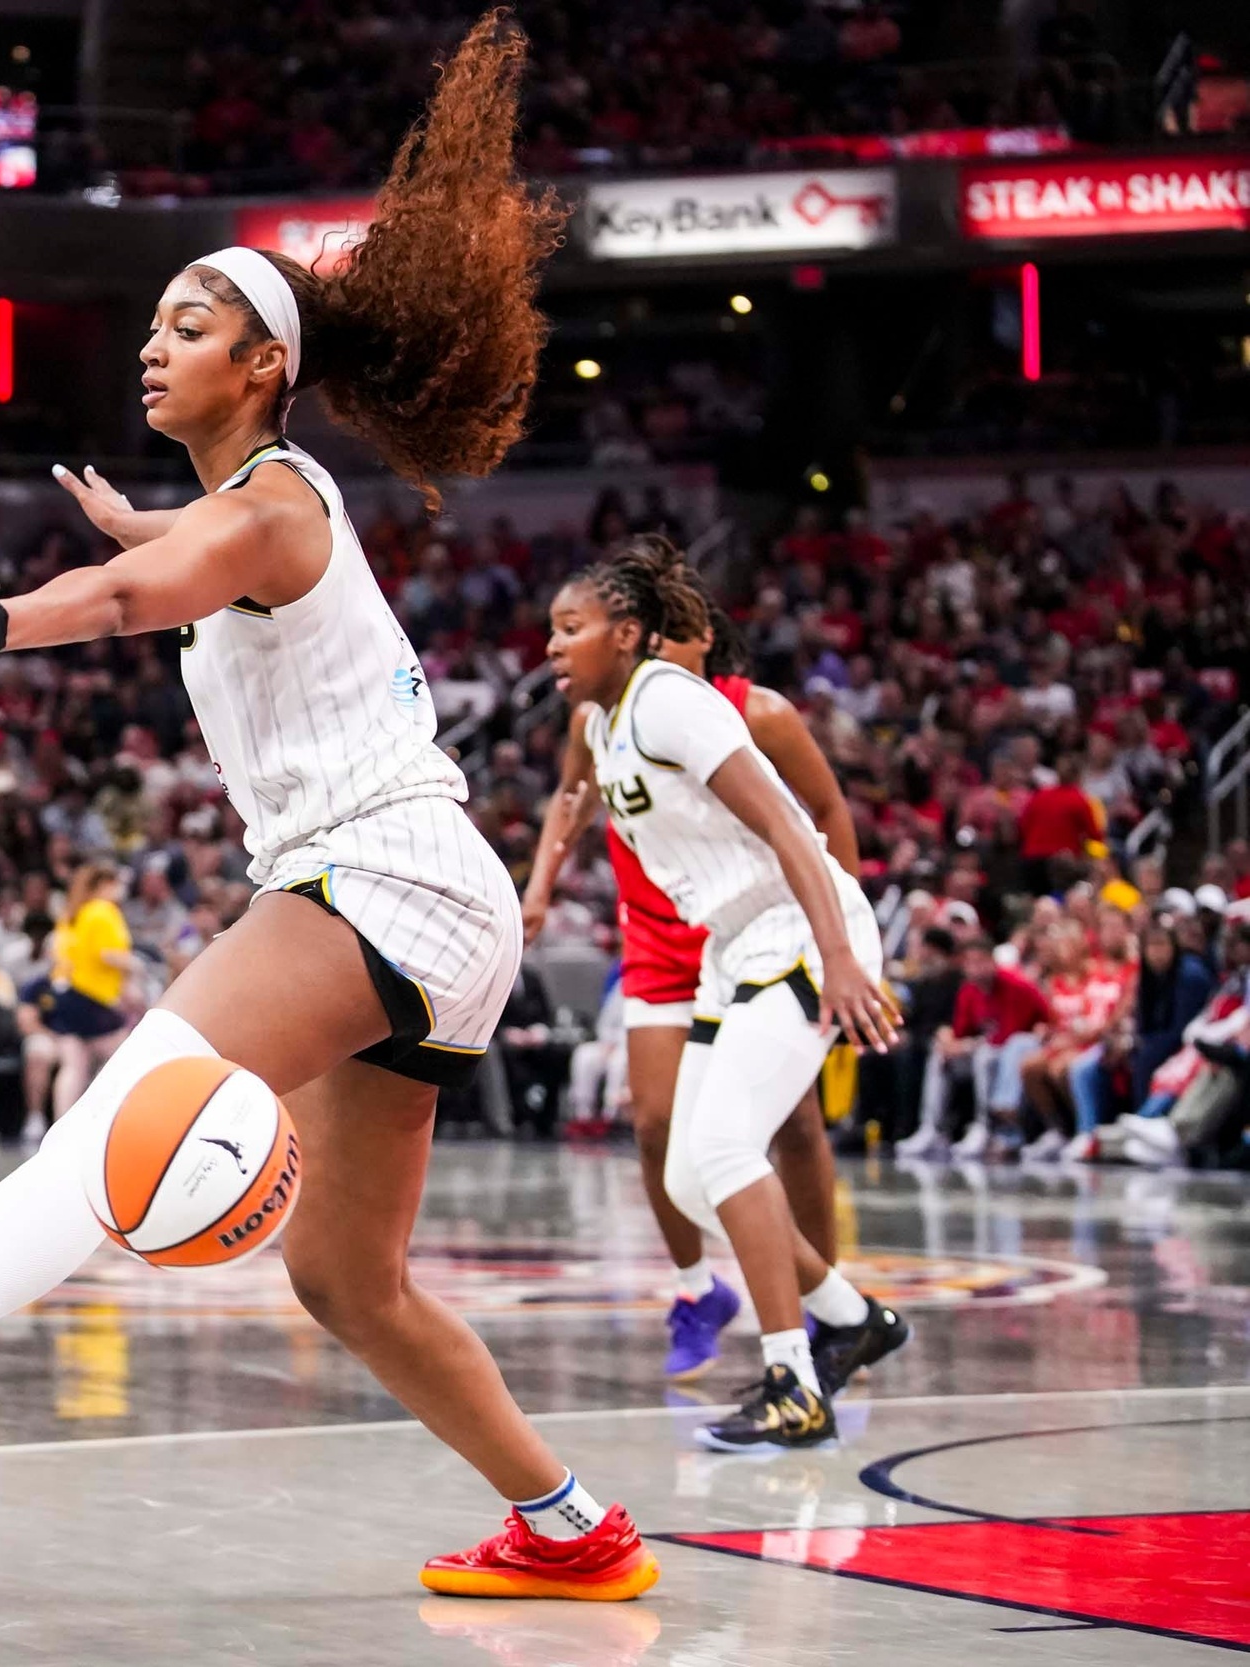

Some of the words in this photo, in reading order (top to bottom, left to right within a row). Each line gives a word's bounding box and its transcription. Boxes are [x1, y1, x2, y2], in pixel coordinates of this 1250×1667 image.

[591, 193, 781, 241] KeyBank
[967, 176, 1097, 221] STEAK
[602, 774, 653, 819] KY
[218, 1133, 300, 1249] Wilson
